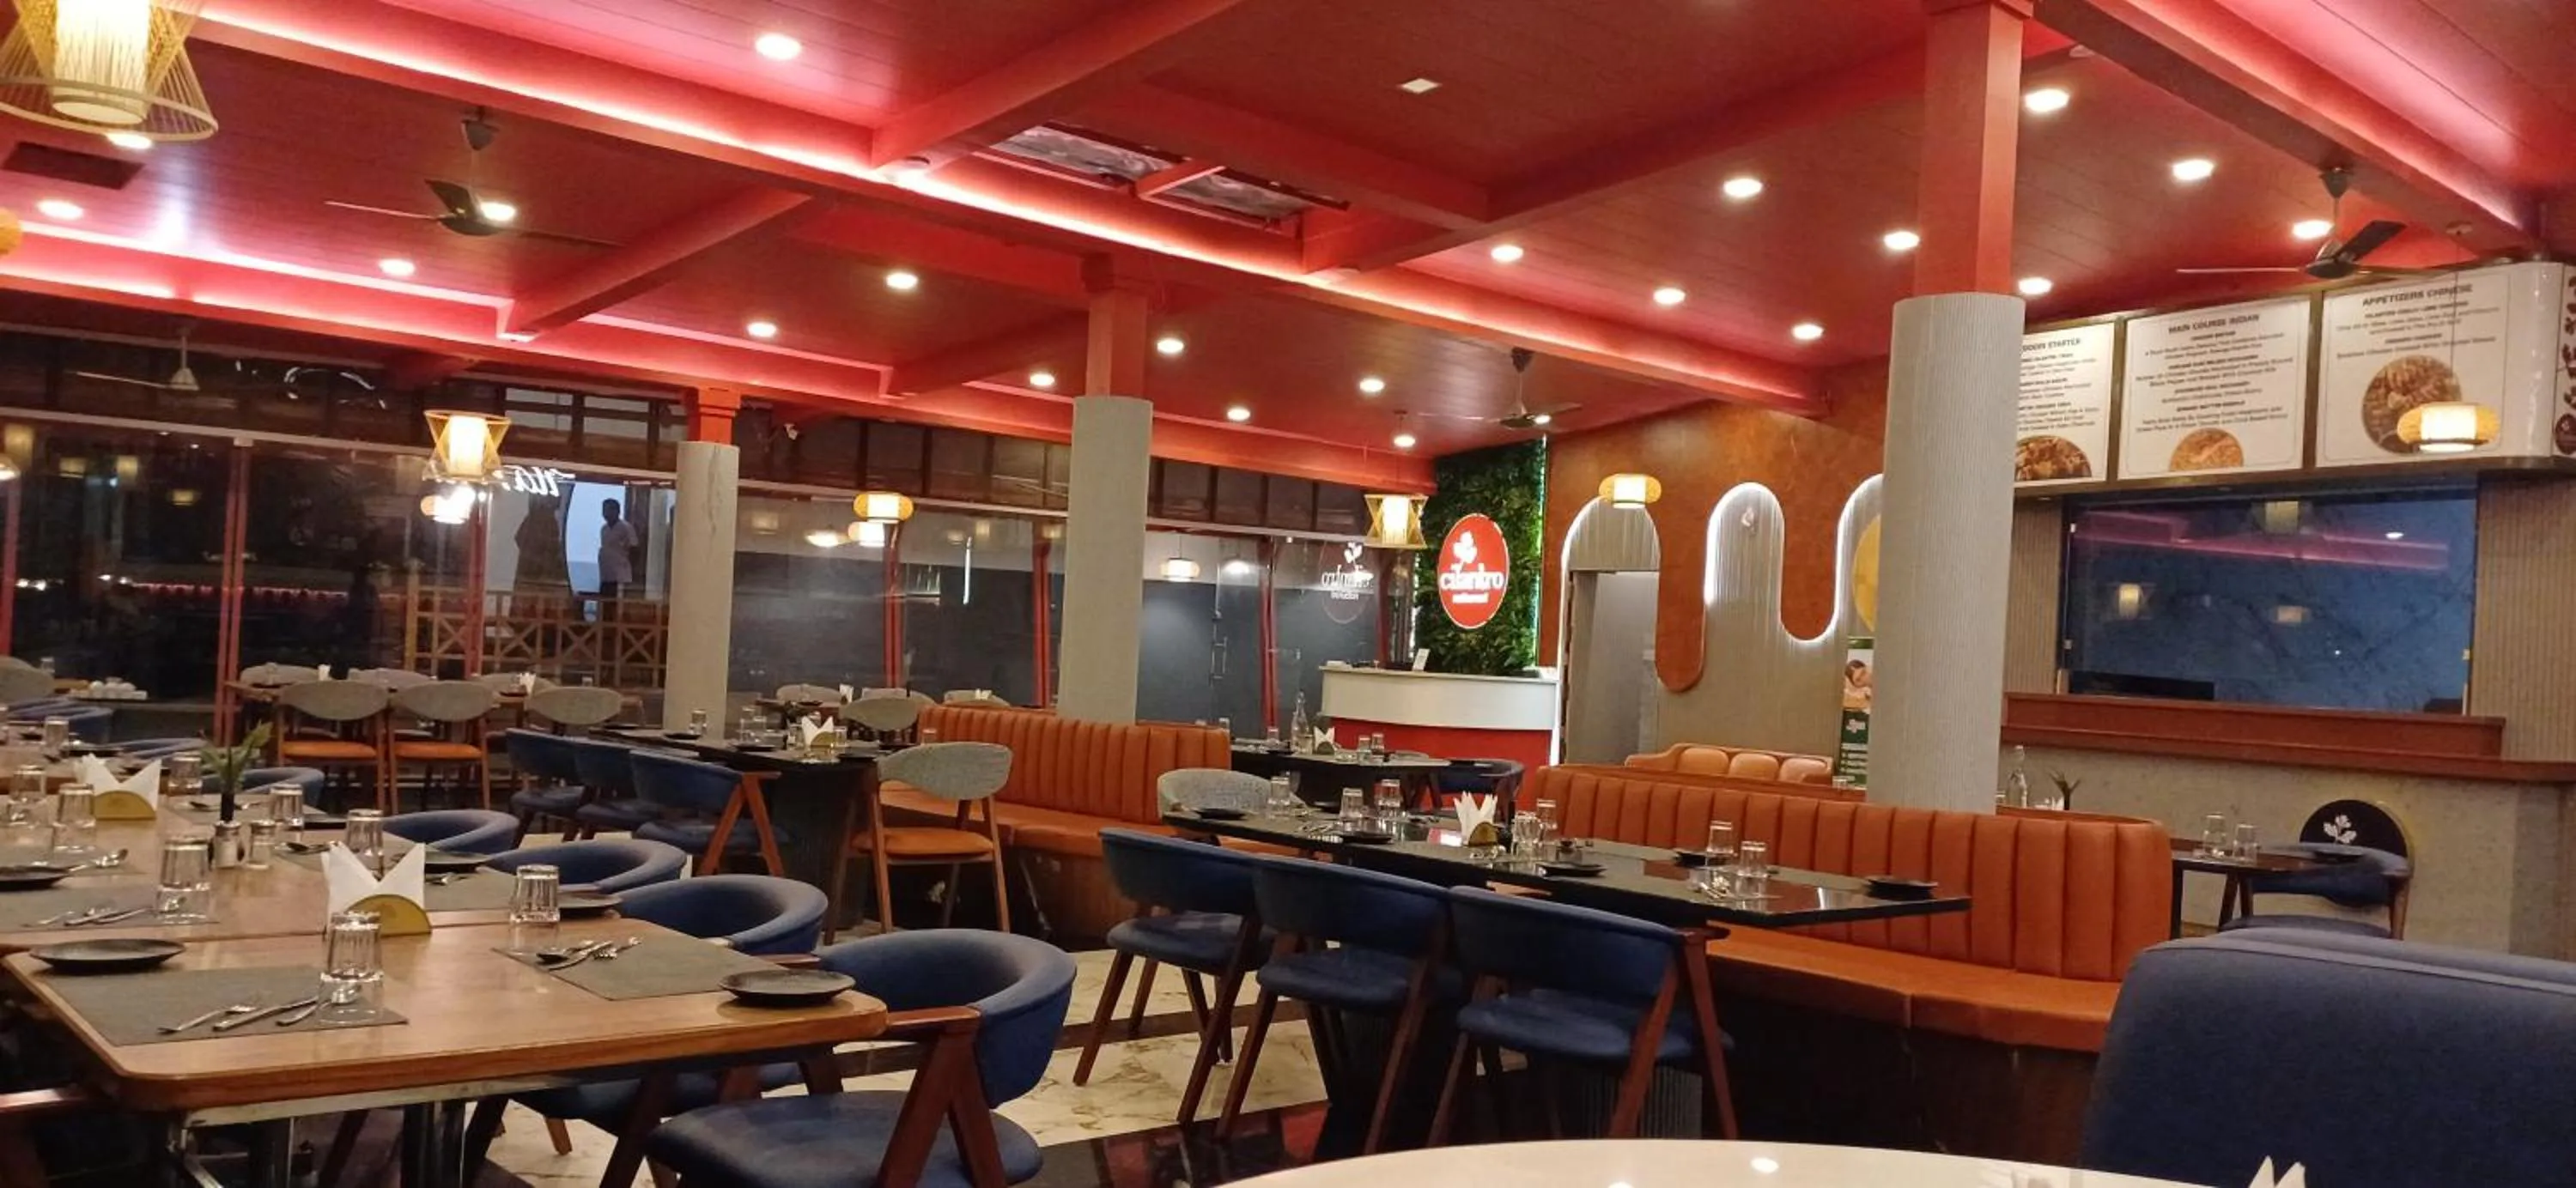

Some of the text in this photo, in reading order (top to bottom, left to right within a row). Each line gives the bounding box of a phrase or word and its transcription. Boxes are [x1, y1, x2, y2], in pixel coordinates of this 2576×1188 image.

[2363, 284, 2472, 306] APPETIZERS CHINESE
[2168, 324, 2190, 335] MAIN
[2192, 318, 2227, 330] COURSE
[1439, 563, 1504, 590] cilantro
